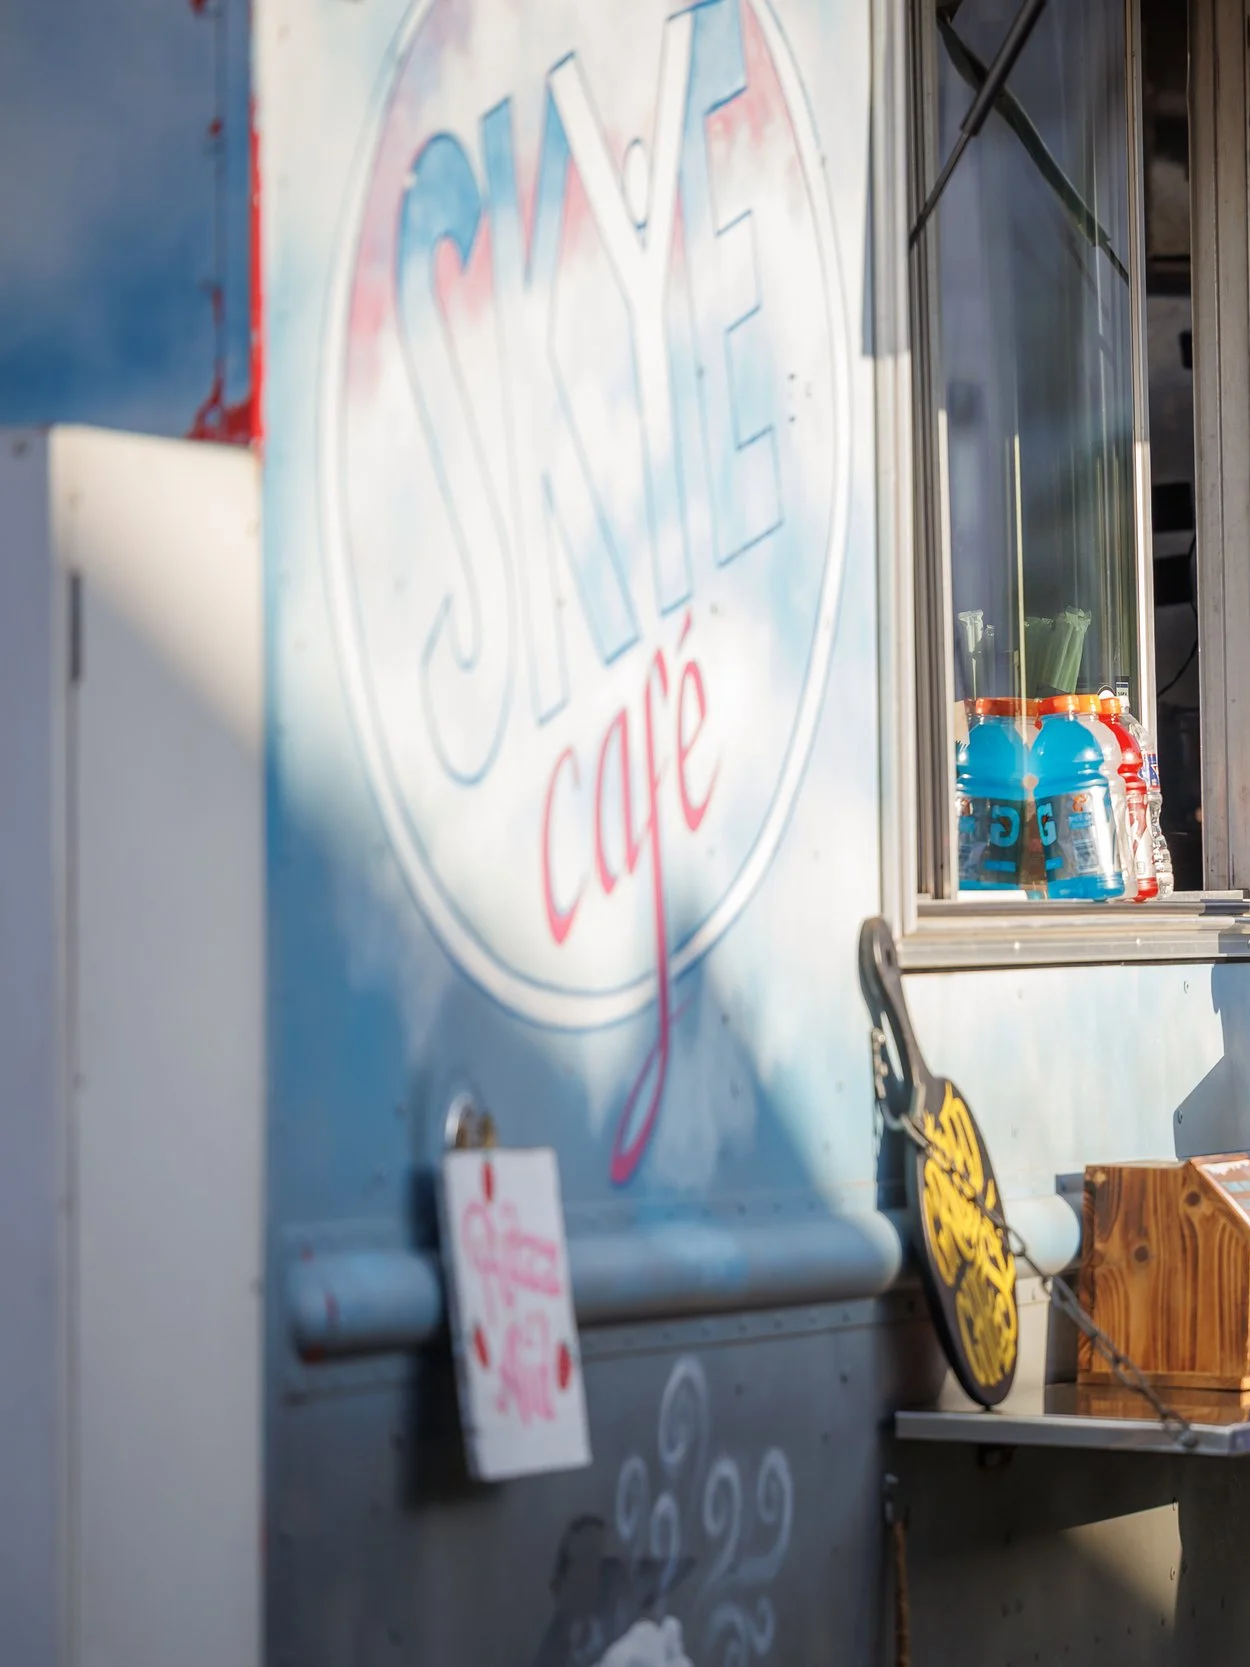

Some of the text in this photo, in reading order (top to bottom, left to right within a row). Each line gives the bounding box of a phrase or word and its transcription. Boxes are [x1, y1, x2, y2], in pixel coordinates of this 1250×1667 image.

[393, 0, 784, 785] SKYE
[541, 608, 723, 1184] café
[1036, 802, 1058, 847] G
